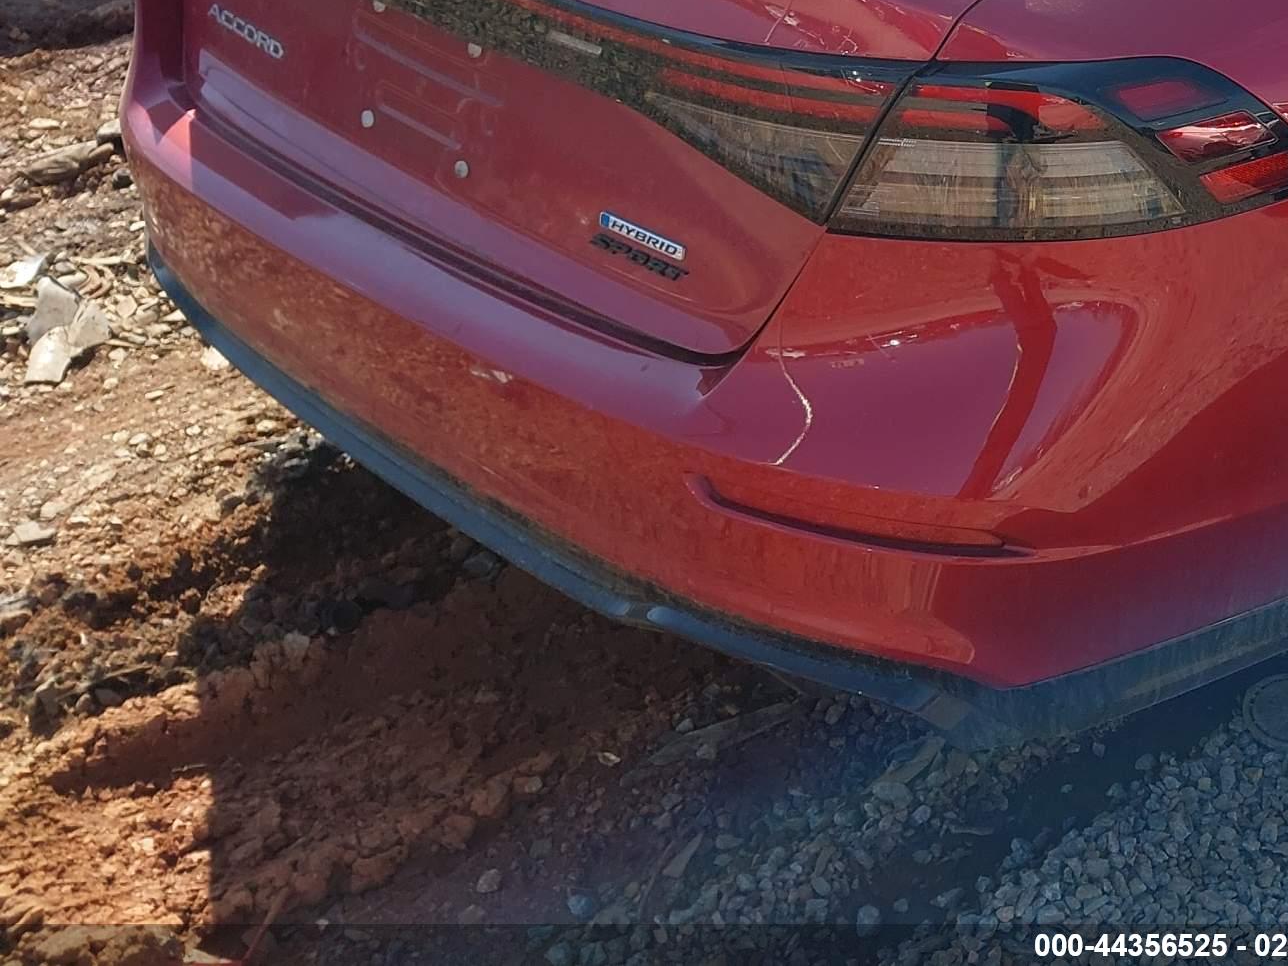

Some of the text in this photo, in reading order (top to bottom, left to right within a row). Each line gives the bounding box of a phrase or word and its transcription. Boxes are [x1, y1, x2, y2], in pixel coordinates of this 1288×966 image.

[207, 3, 284, 59] ACCORD
[590, 234, 690, 281] SPORT
[611, 220, 679, 255] HYBRID
